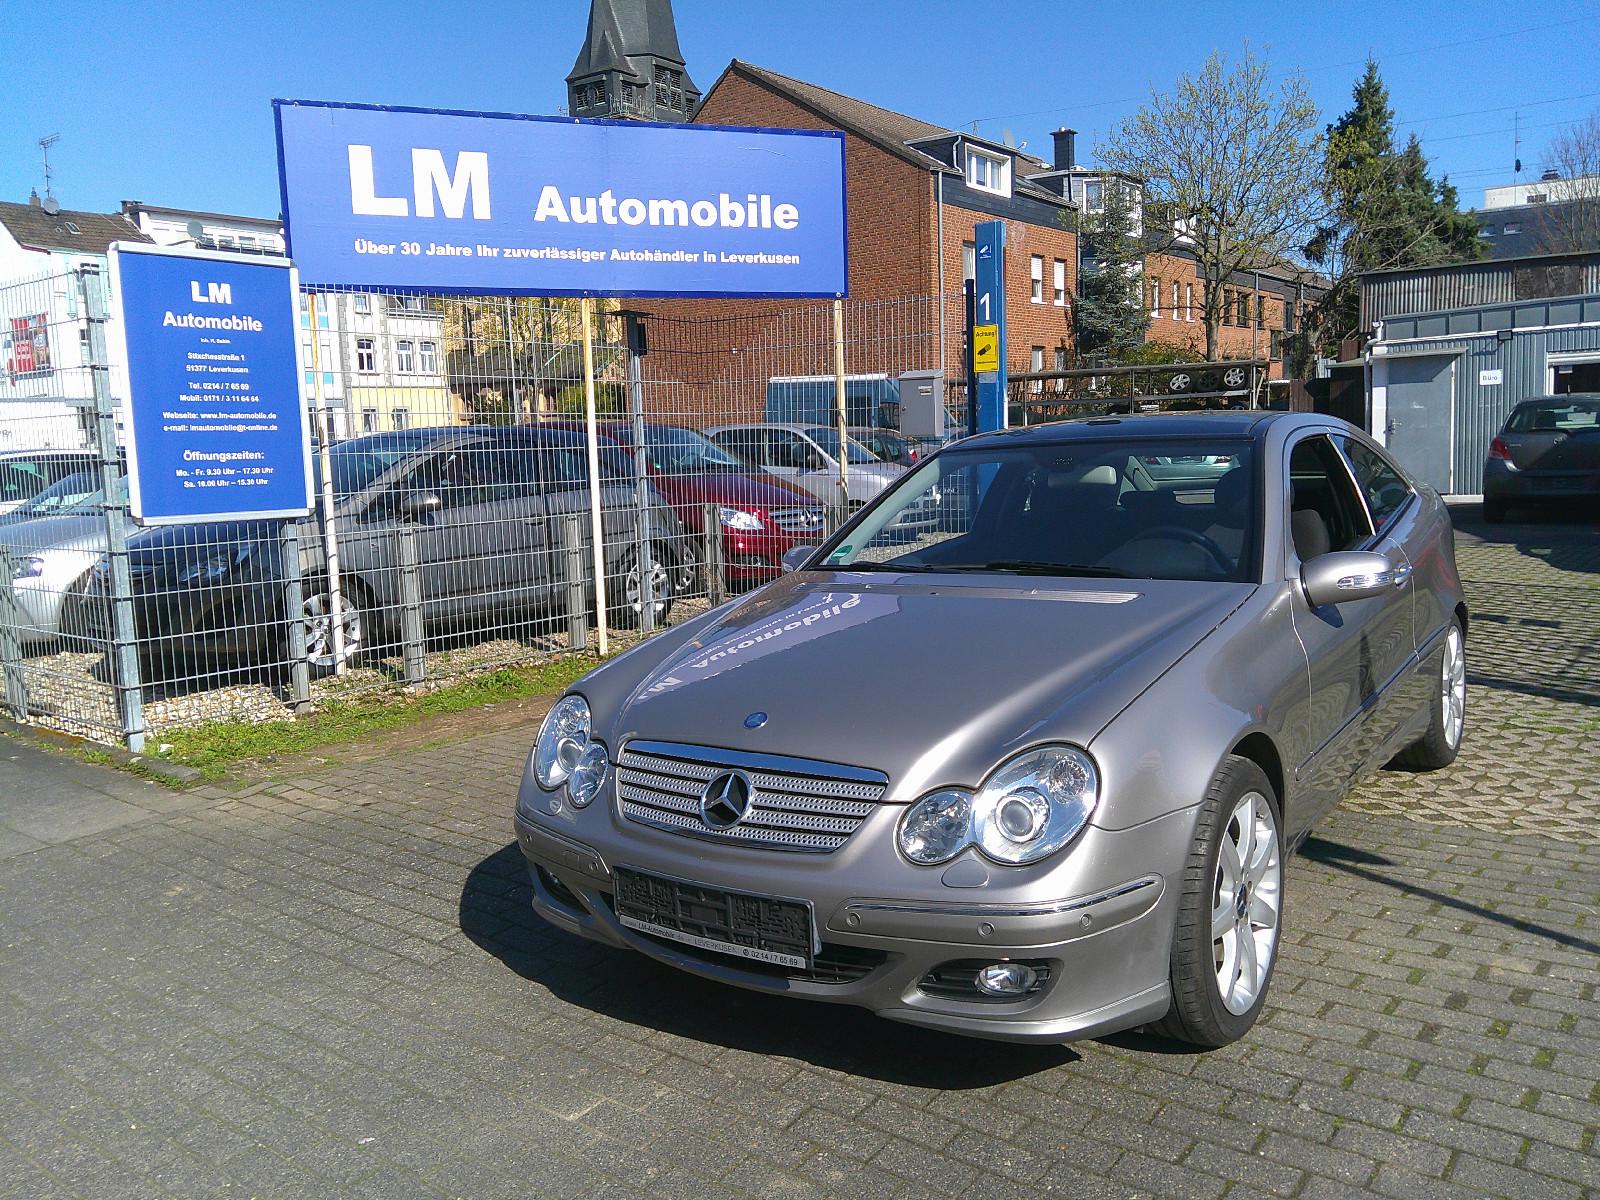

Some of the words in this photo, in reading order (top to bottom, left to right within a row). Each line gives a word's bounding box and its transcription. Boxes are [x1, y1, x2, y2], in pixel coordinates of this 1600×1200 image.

[347, 144, 492, 220] LM
[533, 185, 799, 230] Automobile
[354, 238, 396, 255] Über
[400, 241, 421, 256] 30
[425, 243, 473, 257] Jahre
[476, 244, 500, 257] Ihr
[503, 246, 607, 263] zuverlässiger
[610, 248, 700, 263] Autohändler
[703, 250, 717, 263] in
[720, 251, 800, 265] Leverkusen
[190, 280, 232, 305] LM
[980, 292, 990, 320] 1
[162, 310, 263, 332] Automobile
[185, 364, 207, 372] 51377
[208, 365, 249, 373] Leverkusen
[187, 382, 202, 390] Tel.
[202, 382, 220, 390] 0214
[179, 394, 203, 402] Mobil:
[203, 394, 220, 402] 0171
[162, 411, 199, 420] Webseite:
[163, 424, 189, 432] e-mail:
[183, 449, 265, 463] Öffnungszeiten:
[175, 469, 190, 477] Mo.
[195, 468, 206, 476] Fr.
[206, 468, 222, 476] 9.30
[222, 467, 236, 475] Uhr
[242, 467, 261, 475] 17.30
[183, 480, 196, 488] Sa.
[216, 479, 230, 487] Uhr
